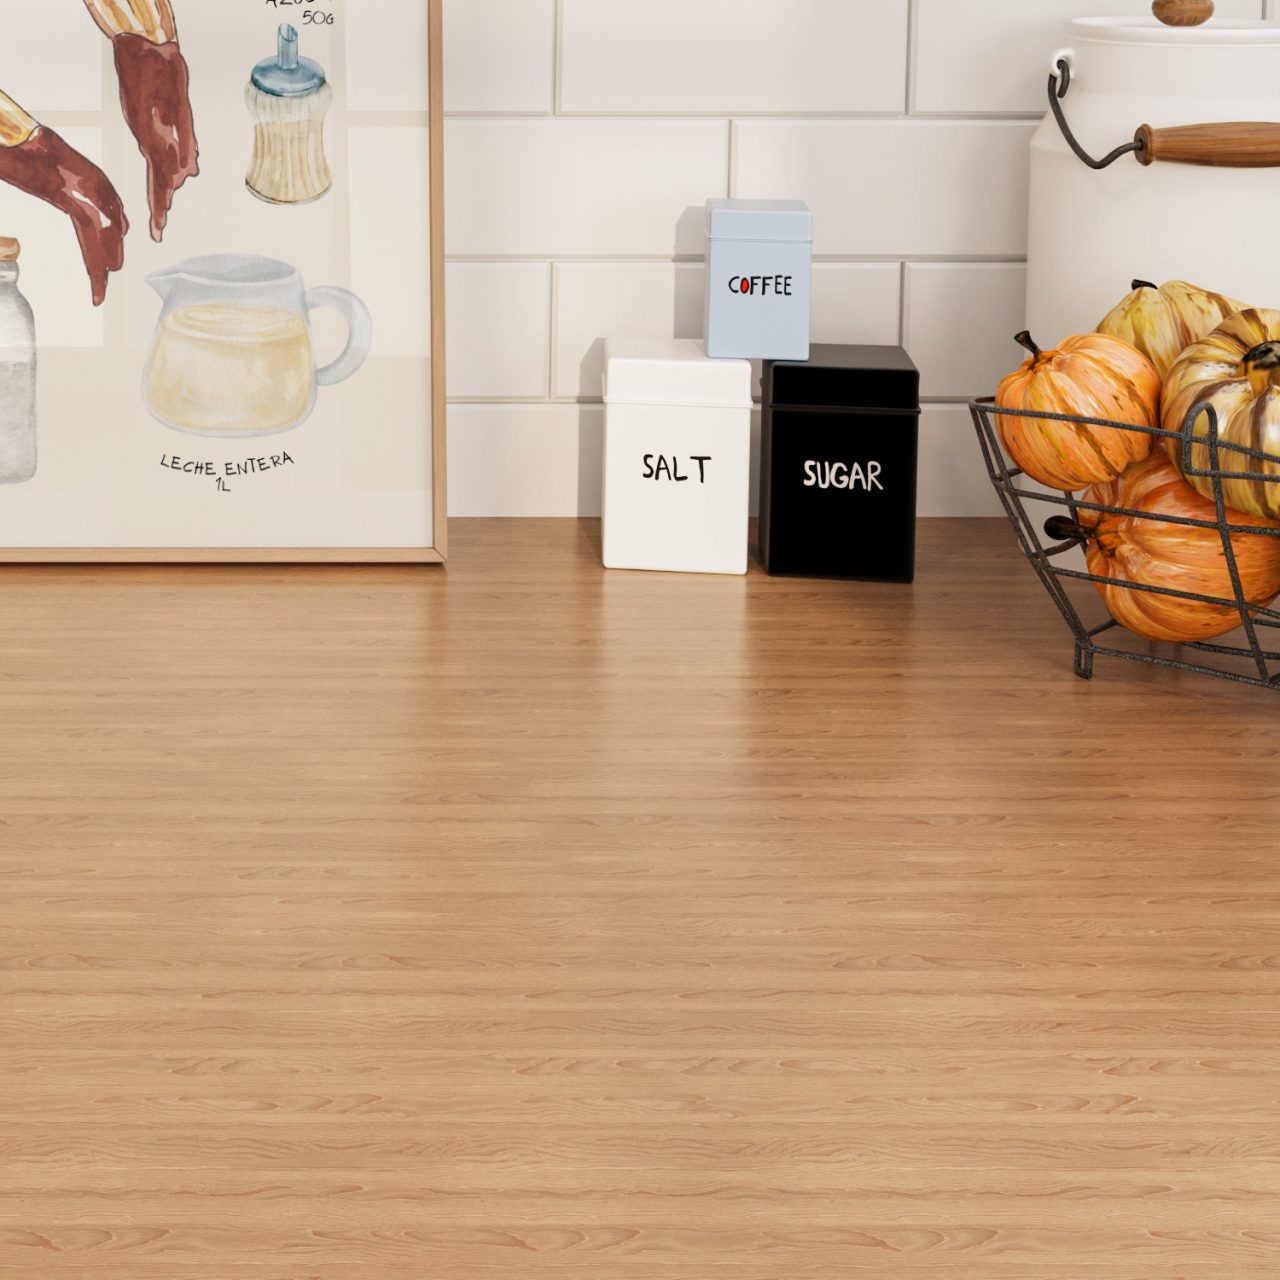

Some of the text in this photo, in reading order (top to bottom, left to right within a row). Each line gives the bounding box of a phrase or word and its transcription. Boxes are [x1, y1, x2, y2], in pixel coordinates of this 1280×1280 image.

[302, 10, 335, 26] 50G
[727, 274, 793, 297] COFFEE
[160, 450, 295, 478] LECHE ENTERA
[641, 453, 713, 484] SALT
[802, 459, 884, 492] SUGAR
[215, 477, 232, 493] 1L
